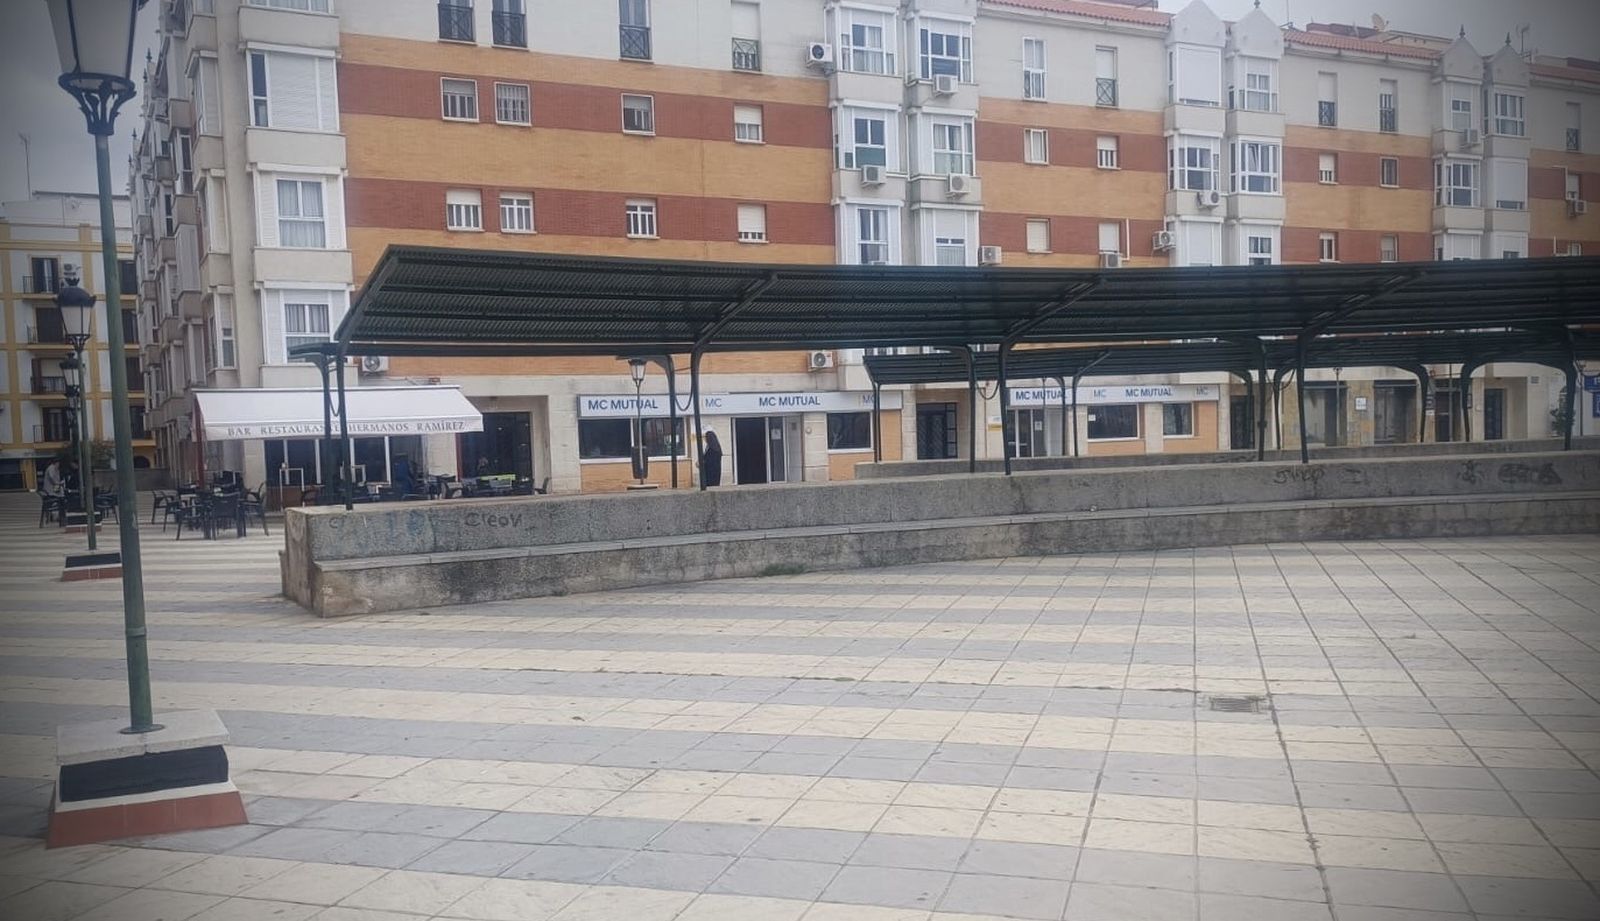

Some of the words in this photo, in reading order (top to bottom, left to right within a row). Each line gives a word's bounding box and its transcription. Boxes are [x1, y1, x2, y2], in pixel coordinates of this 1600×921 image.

[1016, 391, 1031, 400] MC
[1140, 388, 1173, 396] MUTUAL
[588, 399, 608, 410] MC
[610, 399, 658, 410] MUTUAL
[705, 398, 722, 408] MC
[759, 397, 776, 406] MC
[778, 396, 820, 406] MUTUAL
[227, 427, 251, 436] BAR
[348, 422, 409, 432] HERMANOS
